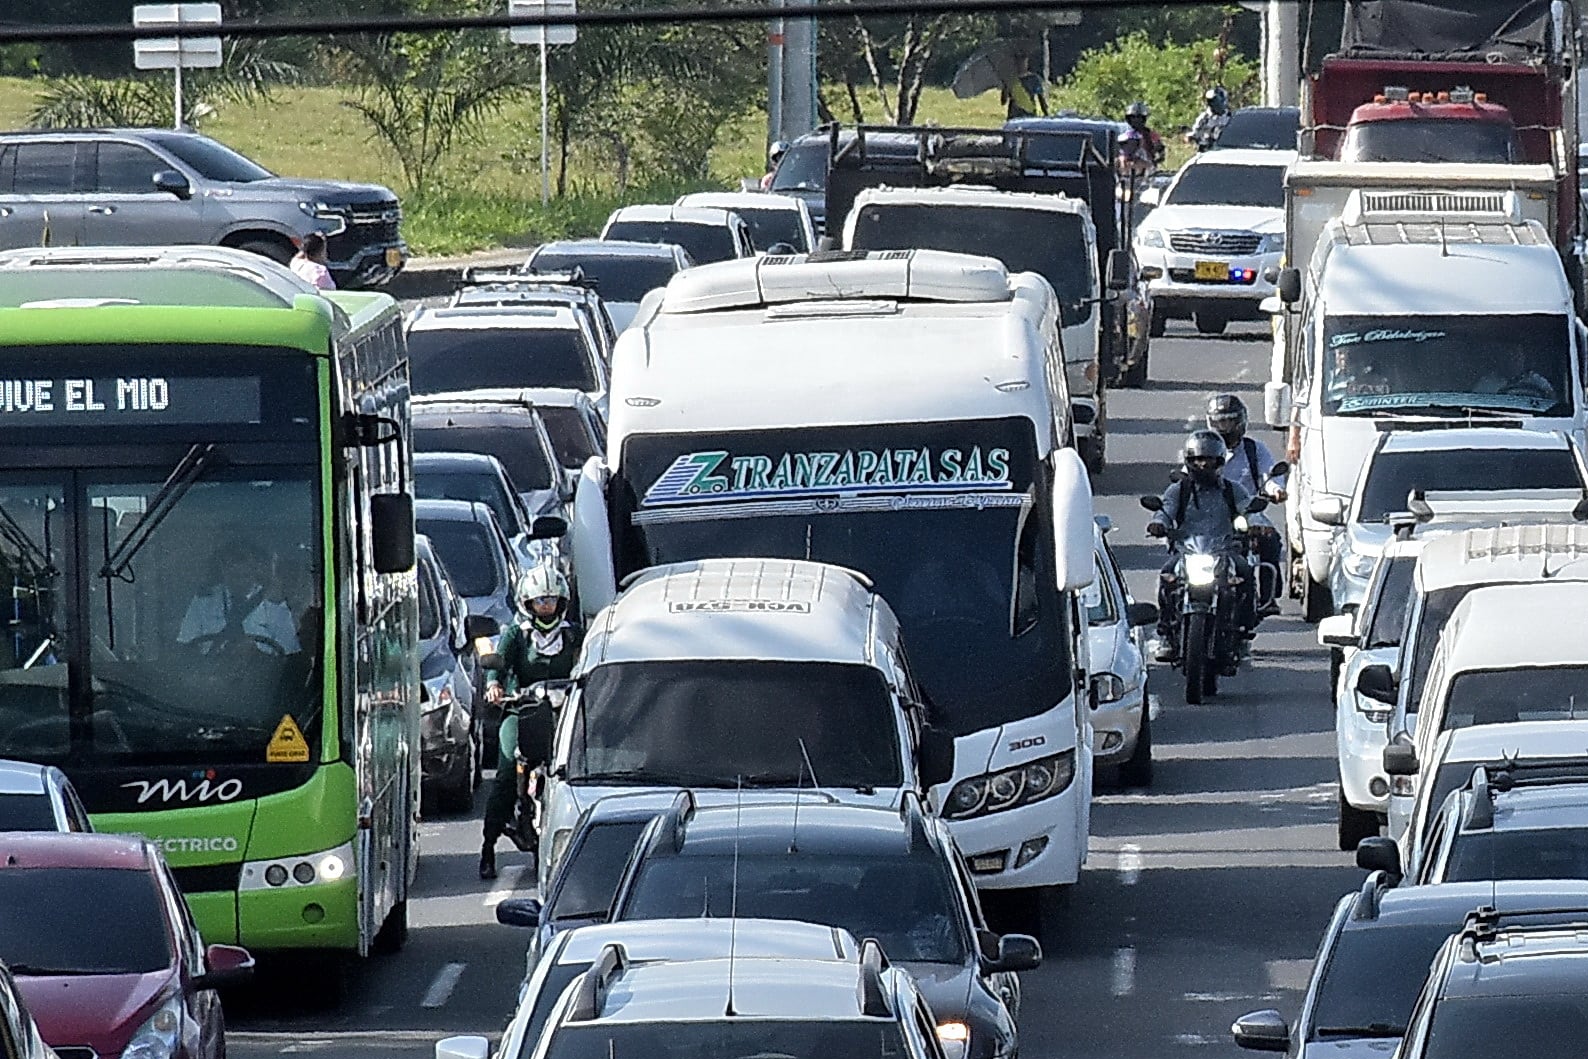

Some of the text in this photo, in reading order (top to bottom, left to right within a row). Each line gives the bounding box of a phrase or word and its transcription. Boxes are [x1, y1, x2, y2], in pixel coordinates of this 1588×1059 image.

[0, 377, 168, 411] IVE EL MIO
[731, 447, 931, 490] TRANZAPATA
